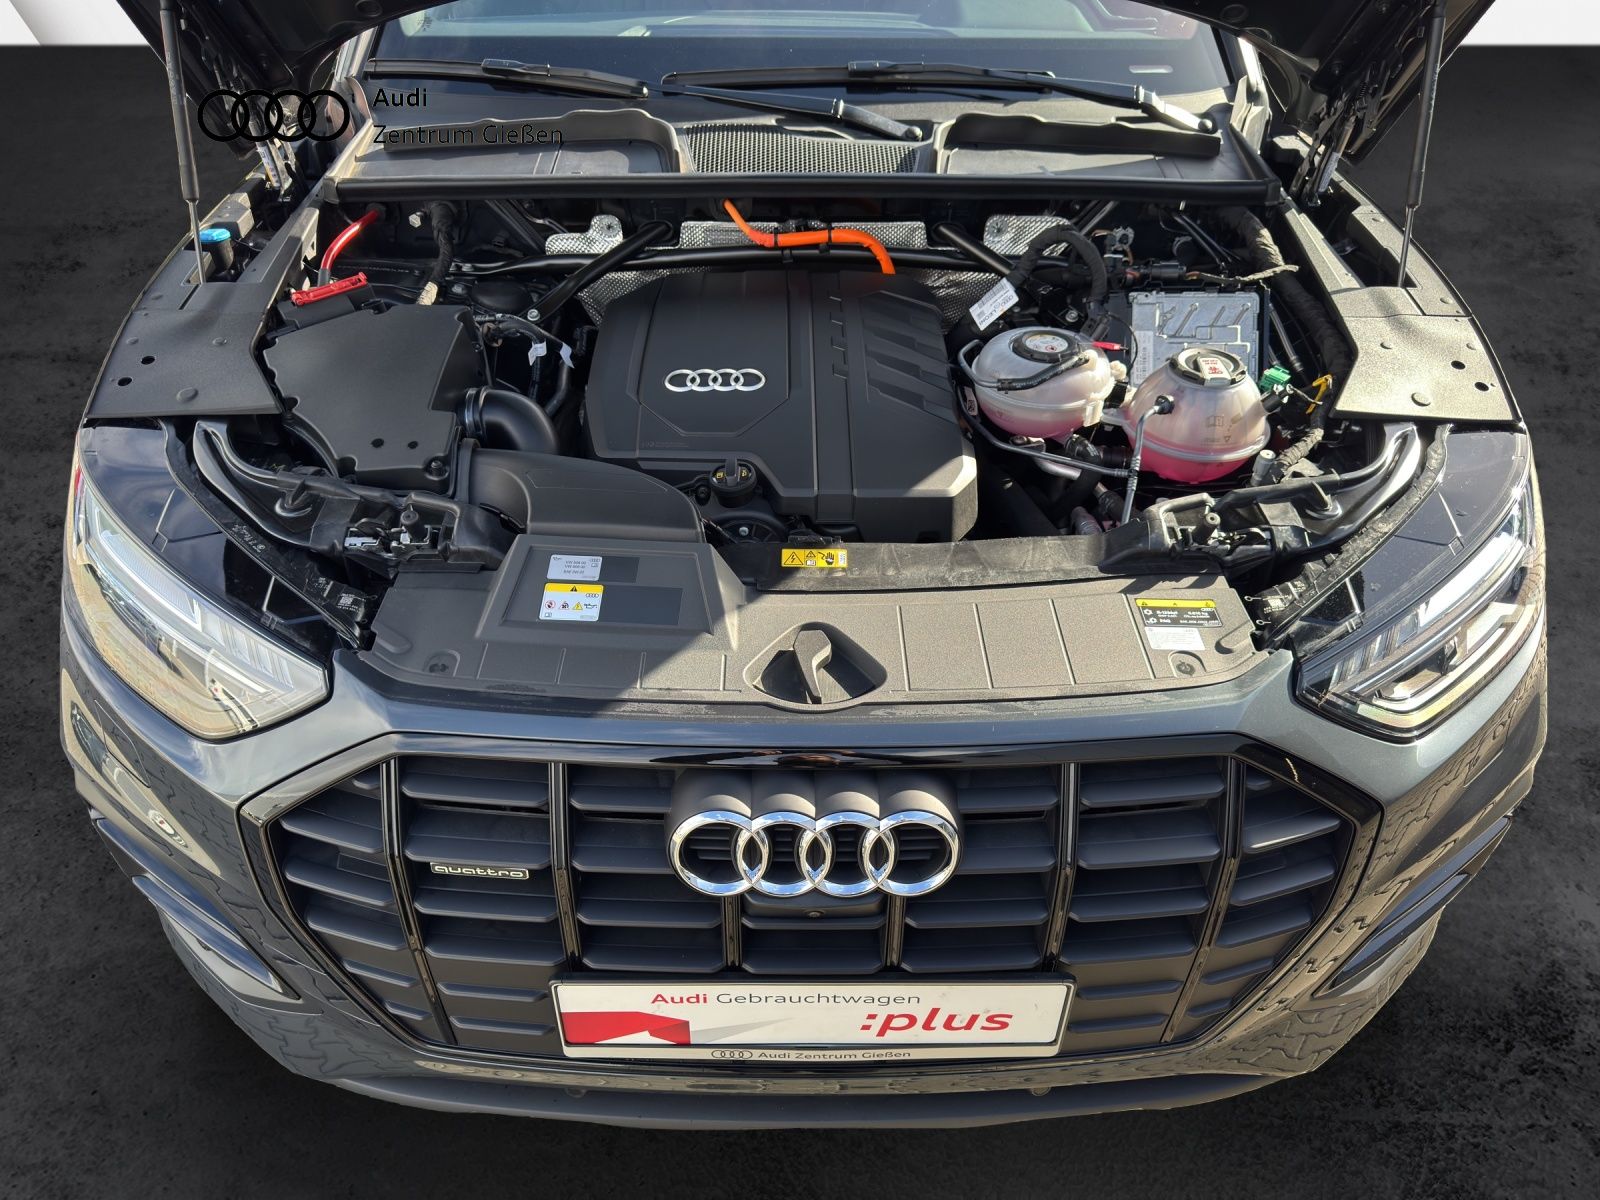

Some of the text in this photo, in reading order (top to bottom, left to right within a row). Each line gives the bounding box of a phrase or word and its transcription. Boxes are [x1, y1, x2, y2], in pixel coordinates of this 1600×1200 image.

[434, 865, 524, 878] quattro
[651, 993, 921, 1007] Audi Gebrauchtwagen
[860, 1007, 1014, 1037] :plus
[758, 1050, 911, 1060] Audi Zentrum Gießen
